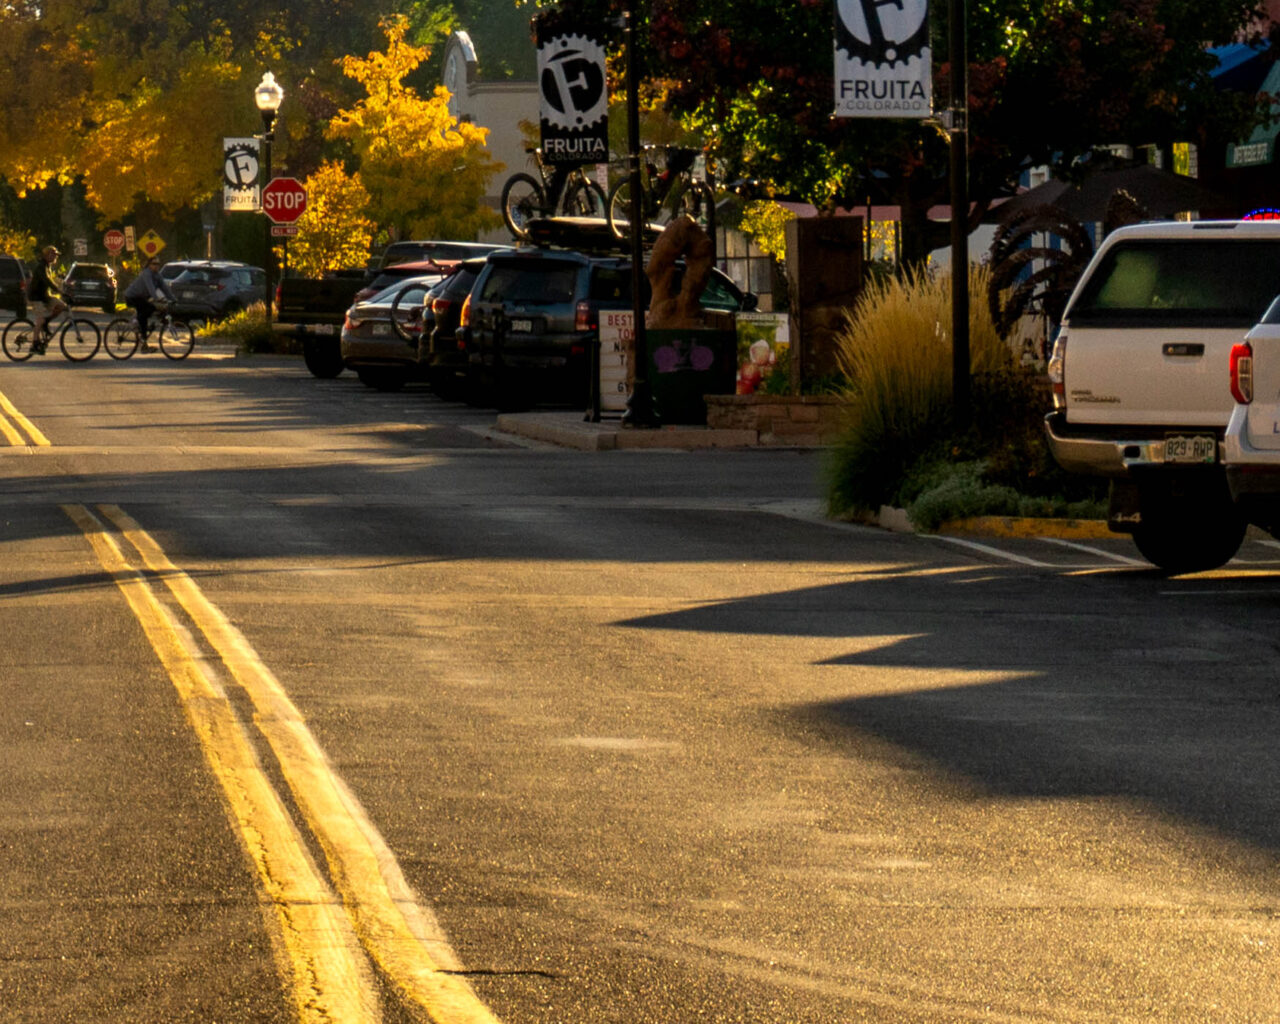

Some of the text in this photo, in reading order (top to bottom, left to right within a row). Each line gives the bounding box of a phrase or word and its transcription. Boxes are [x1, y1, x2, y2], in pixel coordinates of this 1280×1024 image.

[840, 80, 926, 100] FRUITA
[846, 100, 921, 111] COLORADO
[544, 137, 606, 154] FRUITA
[226, 195, 258, 204] FRUITA
[264, 191, 305, 210] STOP
[104, 236, 124, 245] STOP
[608, 314, 633, 326] BEST
